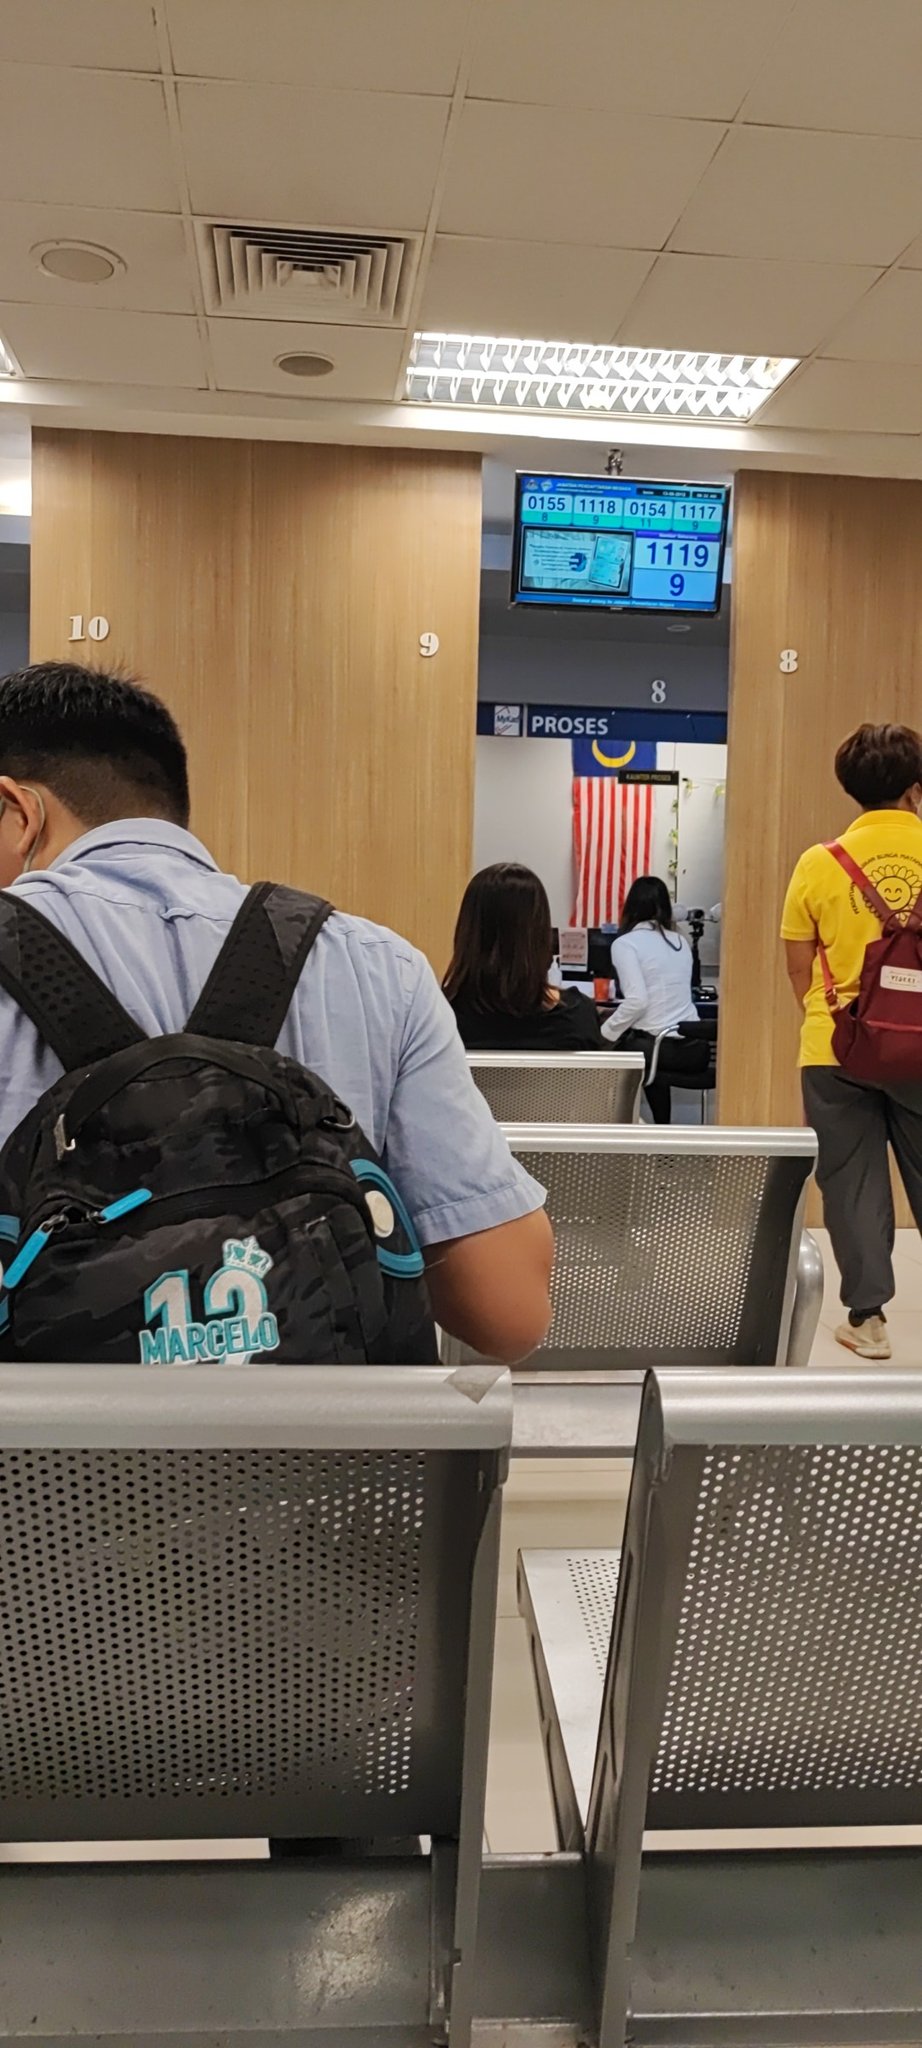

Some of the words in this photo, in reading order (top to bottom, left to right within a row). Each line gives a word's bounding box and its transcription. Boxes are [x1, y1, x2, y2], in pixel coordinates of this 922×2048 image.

[528, 495, 566, 511] 0155
[579, 499, 616, 514] 1118
[630, 501, 666, 517] 0154
[680, 504, 717, 519] 1117
[541, 512, 549, 522] 8
[592, 515, 600, 525] 9
[640, 518, 652, 528] 11
[692, 520, 699, 530] 9
[647, 542, 709, 568] 1119
[669, 573, 685, 596] 9
[68, 614, 110, 642] 10
[419, 632, 440, 657] 9
[779, 649, 798, 673] 8
[651, 680, 667, 704] 8
[531, 715, 609, 735] PROSES
[139, 1312, 280, 1364] MARCELO
